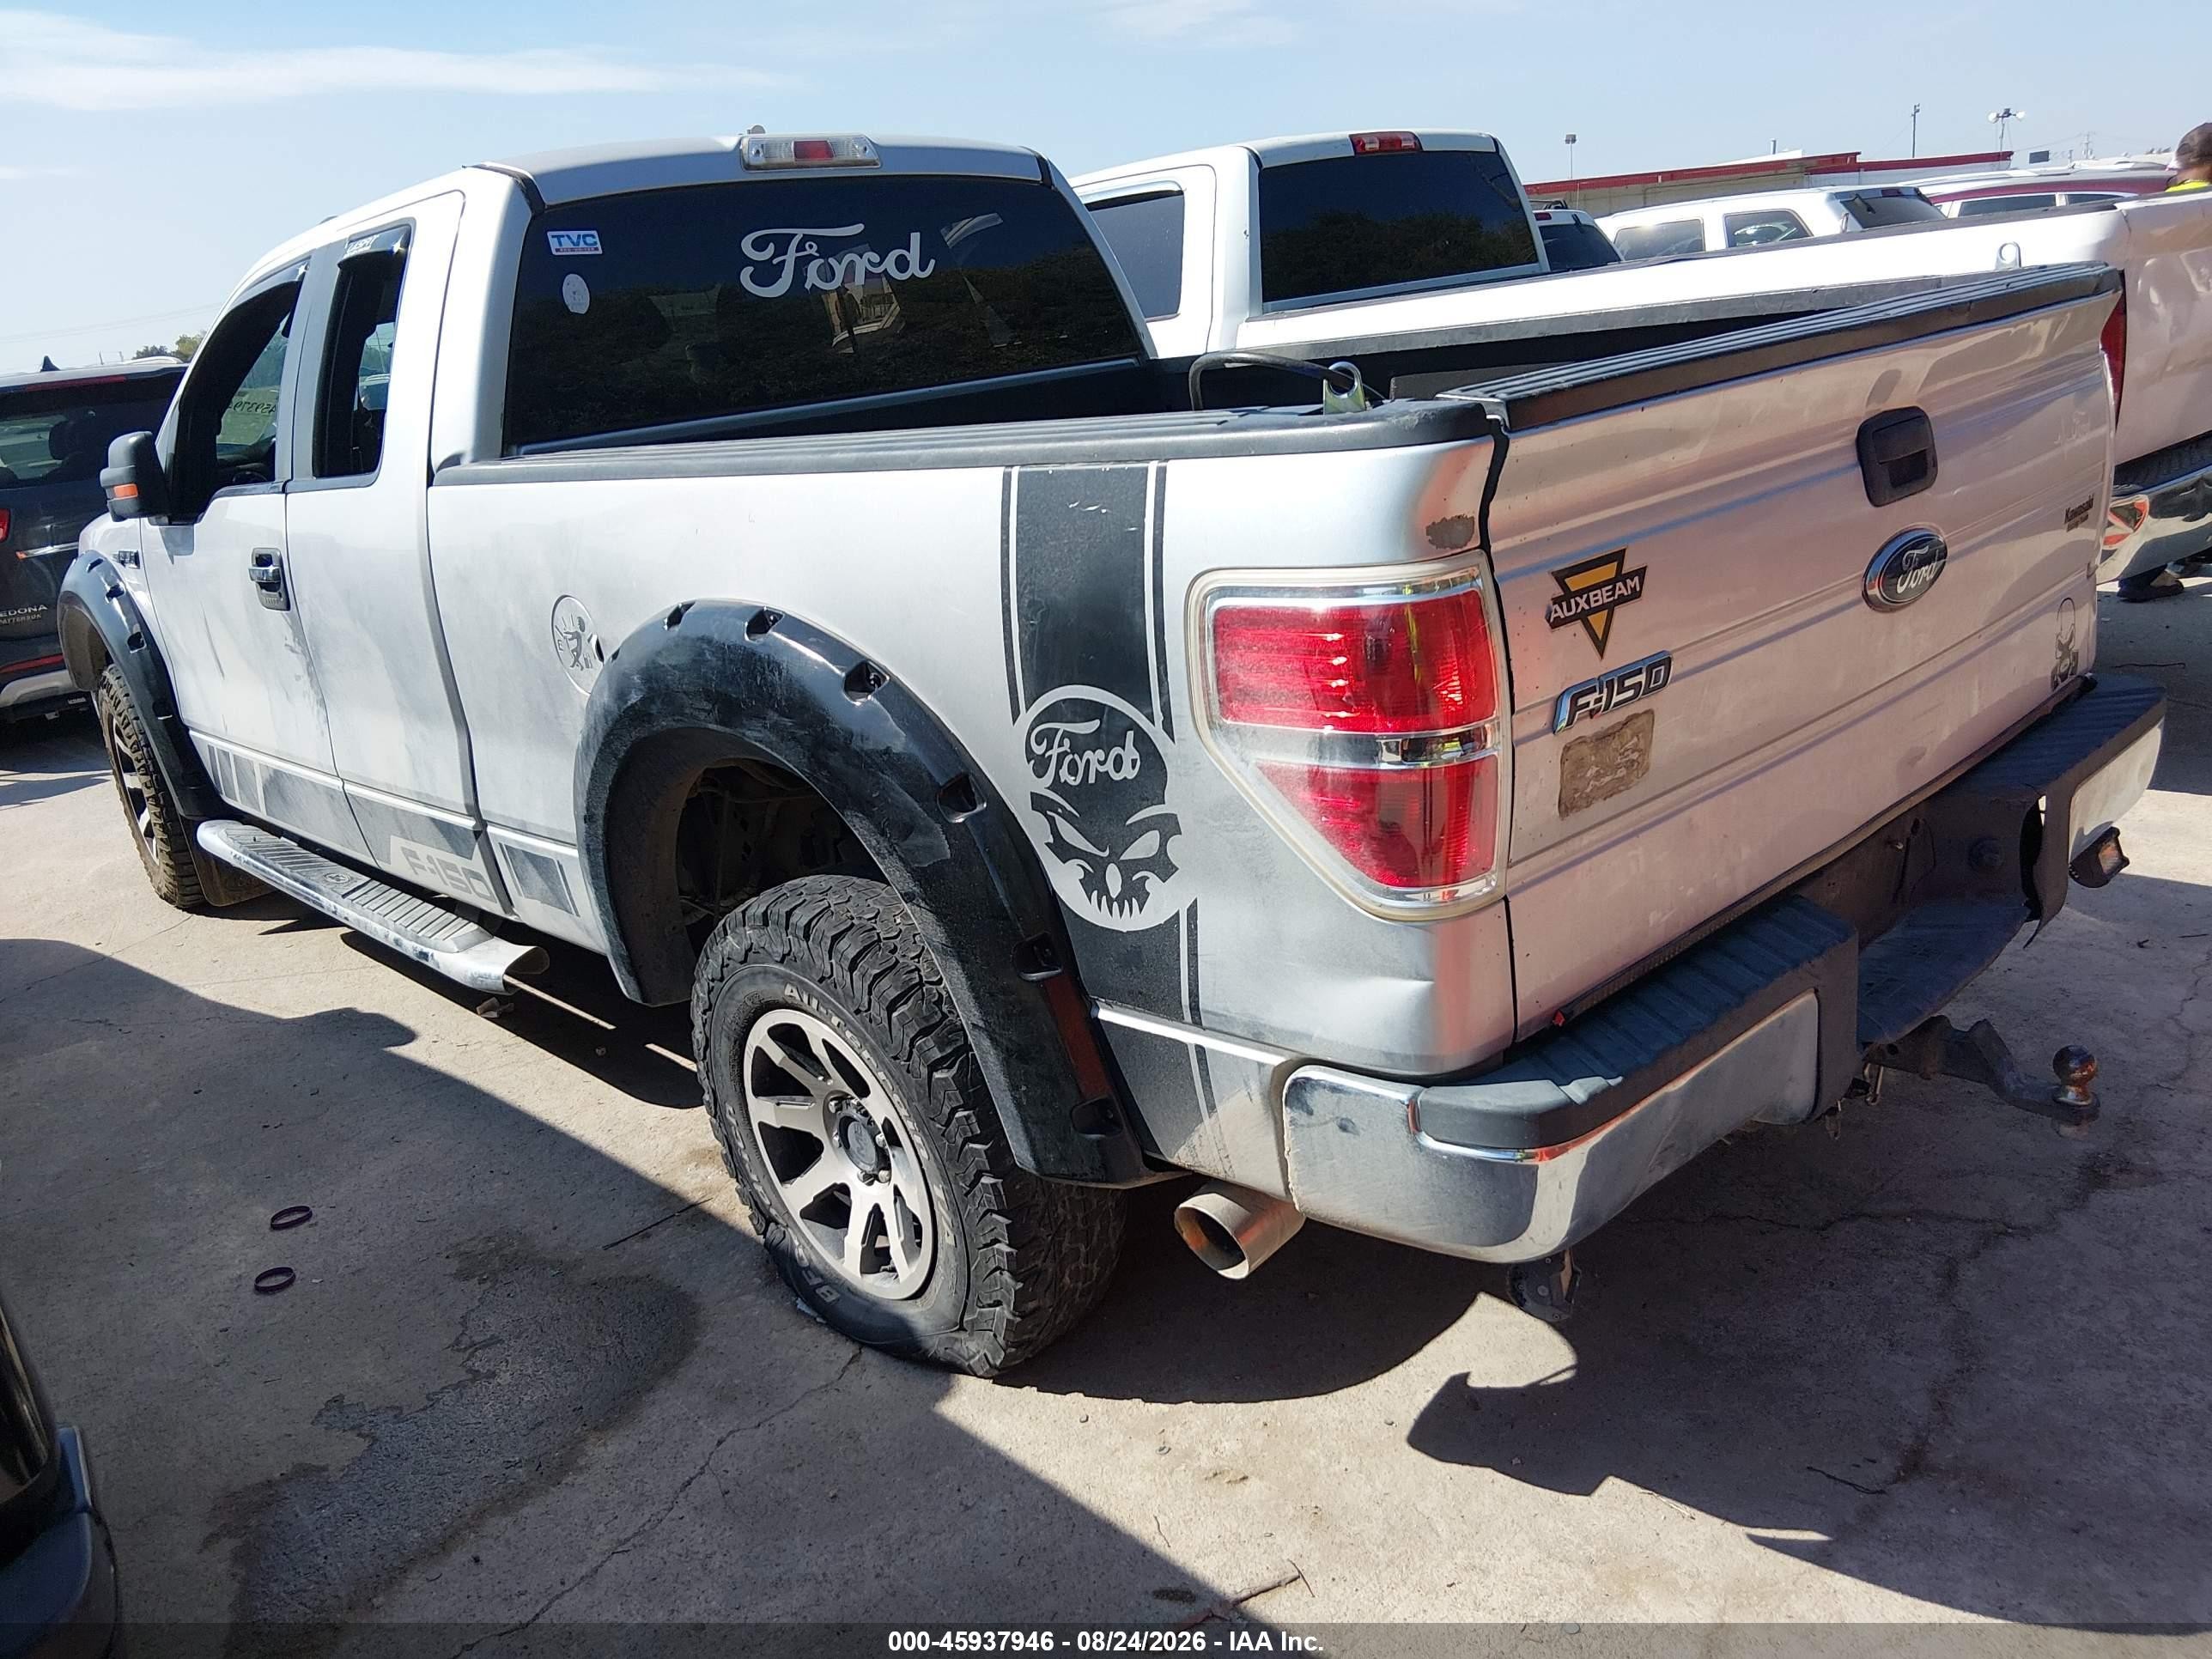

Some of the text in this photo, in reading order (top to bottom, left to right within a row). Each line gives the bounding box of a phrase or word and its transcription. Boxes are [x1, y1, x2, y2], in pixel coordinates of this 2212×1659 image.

[551, 234, 598, 247] TVC
[739, 222, 936, 298] Ford
[1896, 545, 1940, 594] Ford
[0, 613, 42, 624] ATTERSON
[1549, 575, 1641, 623] AUXBEAM
[1553, 650, 1674, 735] F-150
[1030, 719, 1141, 788] Ford
[399, 846, 498, 904] F-150
